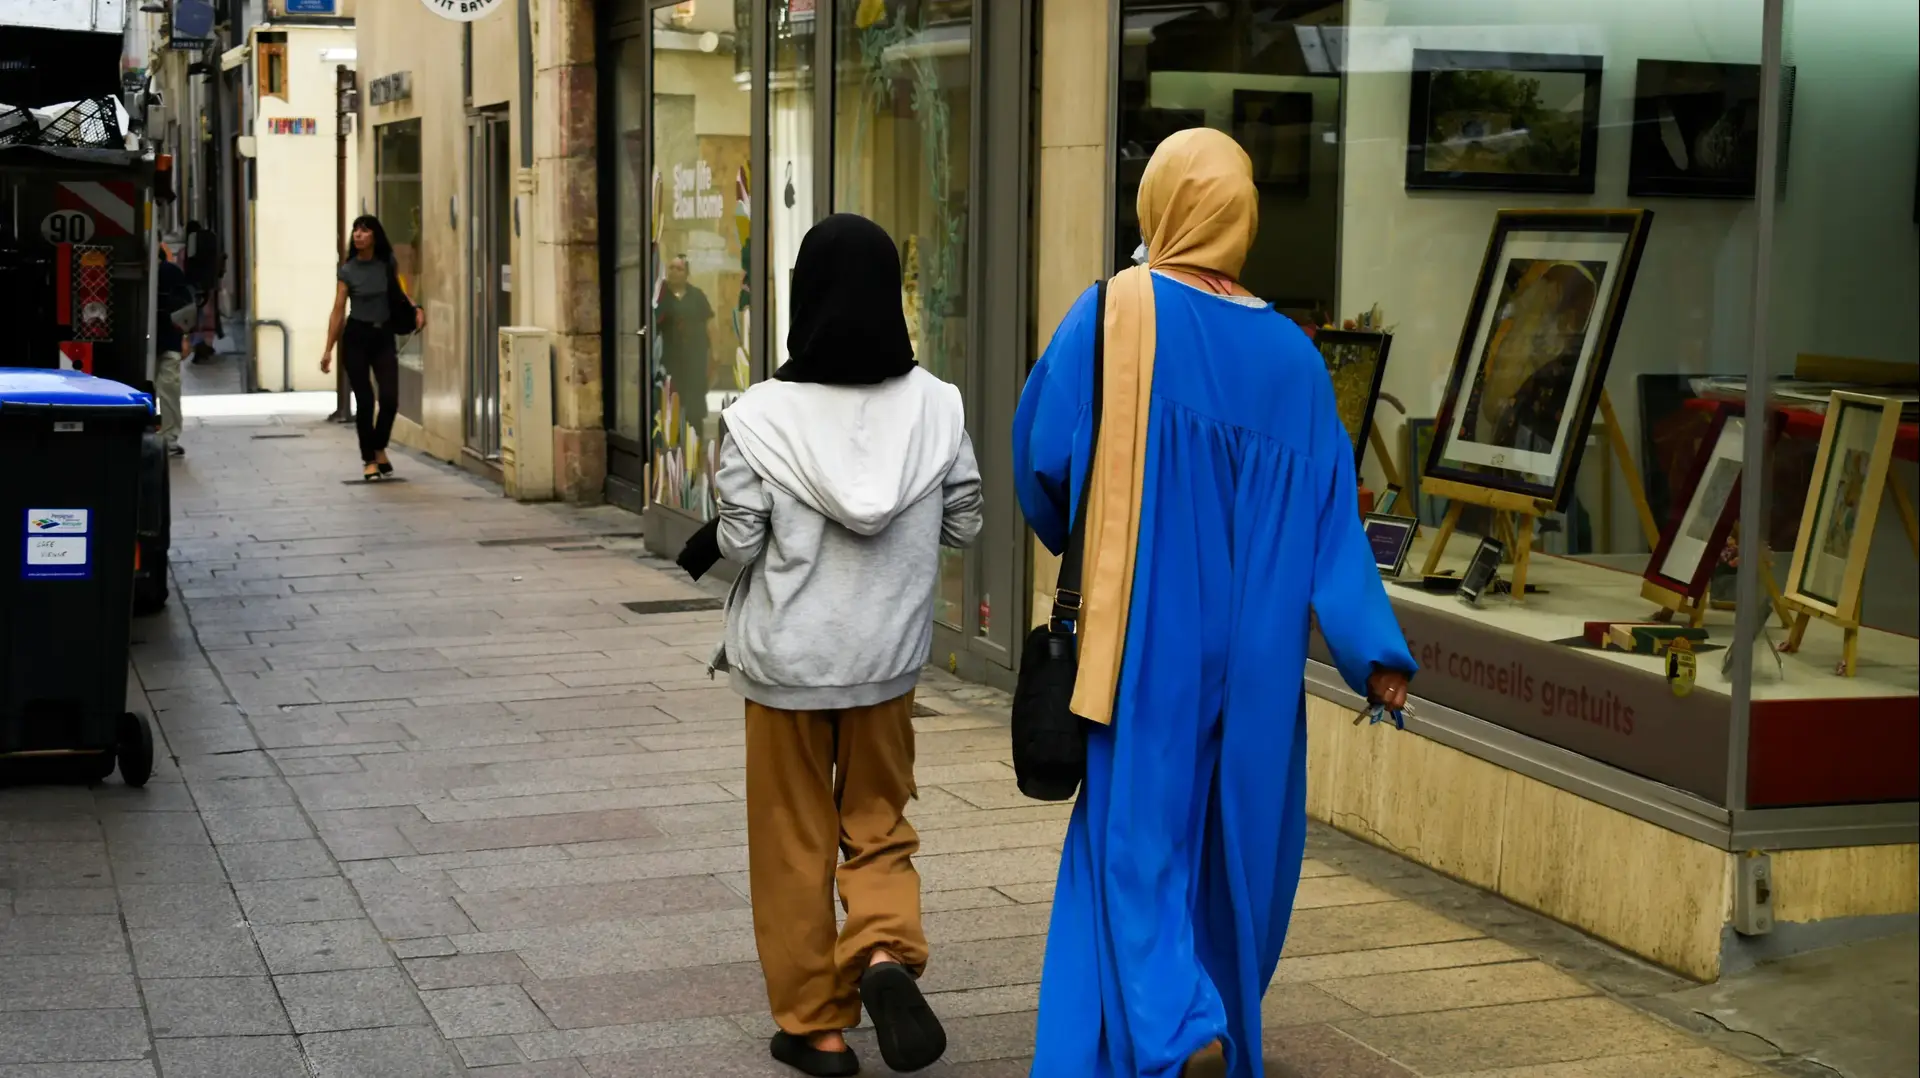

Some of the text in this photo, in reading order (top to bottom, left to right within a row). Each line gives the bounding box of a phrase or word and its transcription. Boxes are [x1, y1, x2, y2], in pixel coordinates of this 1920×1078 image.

[50, 214, 85, 243] 90
[1421, 641, 1442, 672] et
[1447, 650, 1535, 703] conseils
[1541, 680, 1636, 737] gratuits
